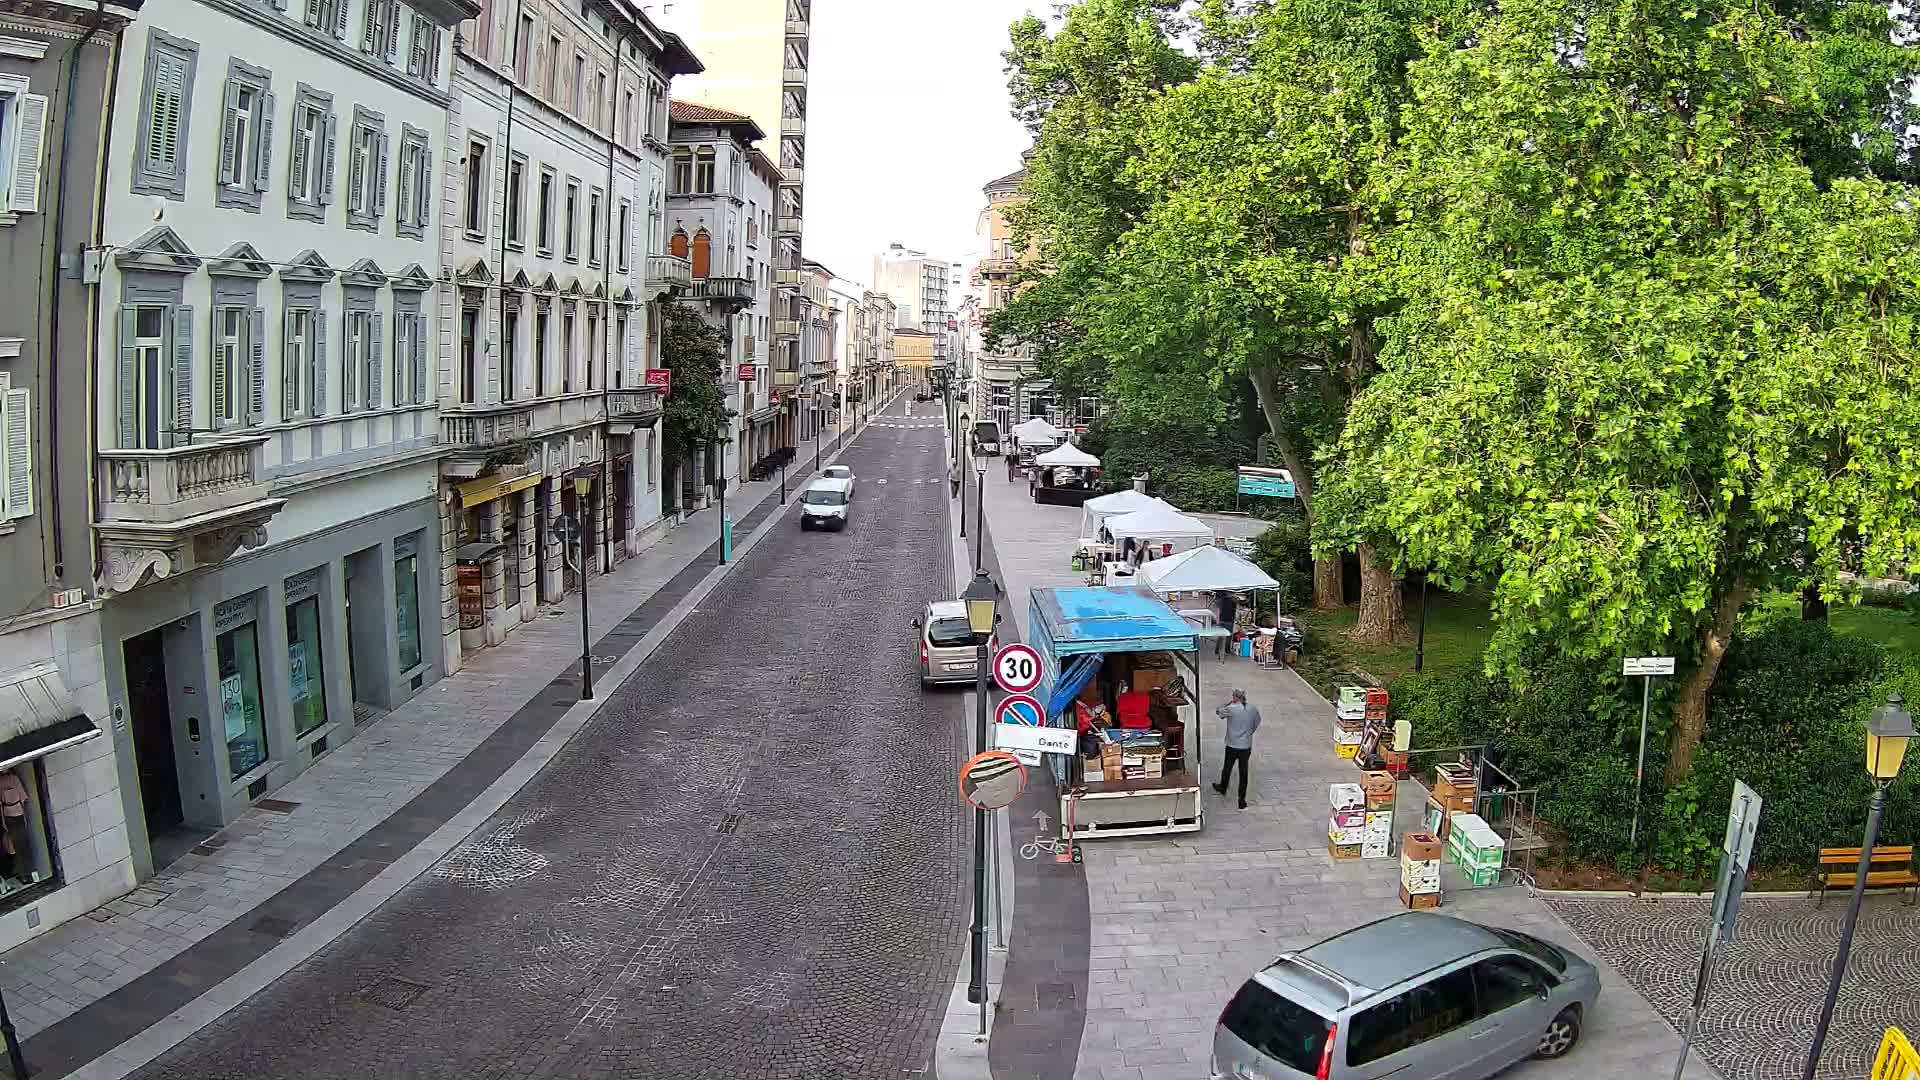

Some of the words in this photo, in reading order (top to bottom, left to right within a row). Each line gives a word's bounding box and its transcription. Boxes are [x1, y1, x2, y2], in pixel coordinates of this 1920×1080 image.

[1005, 657, 1032, 680] 30
[221, 678, 240, 700] 130
[1038, 737, 1070, 749] Dante
